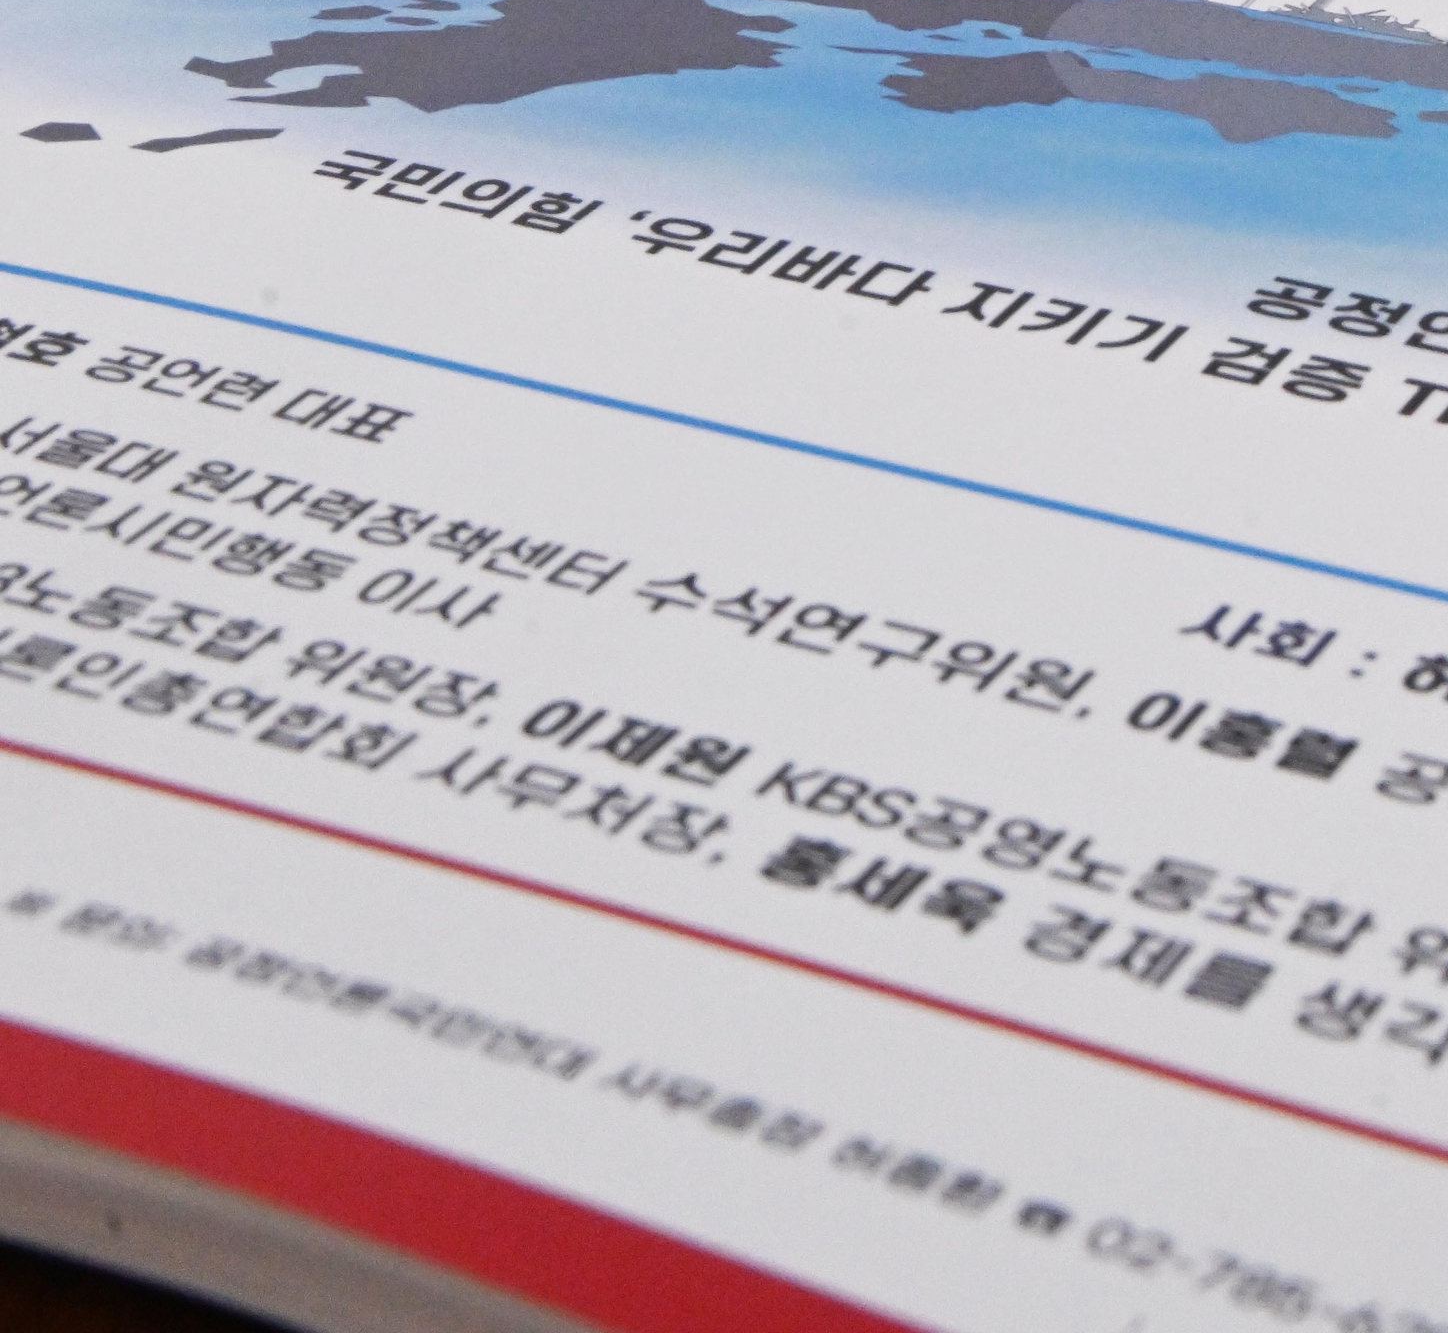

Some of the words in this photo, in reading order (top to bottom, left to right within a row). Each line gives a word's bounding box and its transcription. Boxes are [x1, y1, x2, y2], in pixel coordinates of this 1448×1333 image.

[84, 345, 281, 411] 공언련
[272, 388, 416, 445] 대표
[312, 149, 607, 237] 국민의힘
[940, 280, 1190, 364] 지키기
[1202, 337, 1371, 404] 검증
[0, 416, 180, 484] 서울대
[170, 459, 631, 595] 원자력정책센터
[635, 572, 1098, 718] 수석연구위원,
[356, 567, 505, 630] 이사
[1179, 603, 1338, 669] 사회
[0, 626, 418, 773] 론인총연합회
[1024, 901, 1275, 1013] 경제를
[284, 636, 502, 727] 위원장,
[757, 758, 1378, 959] KBS공영노동조합
